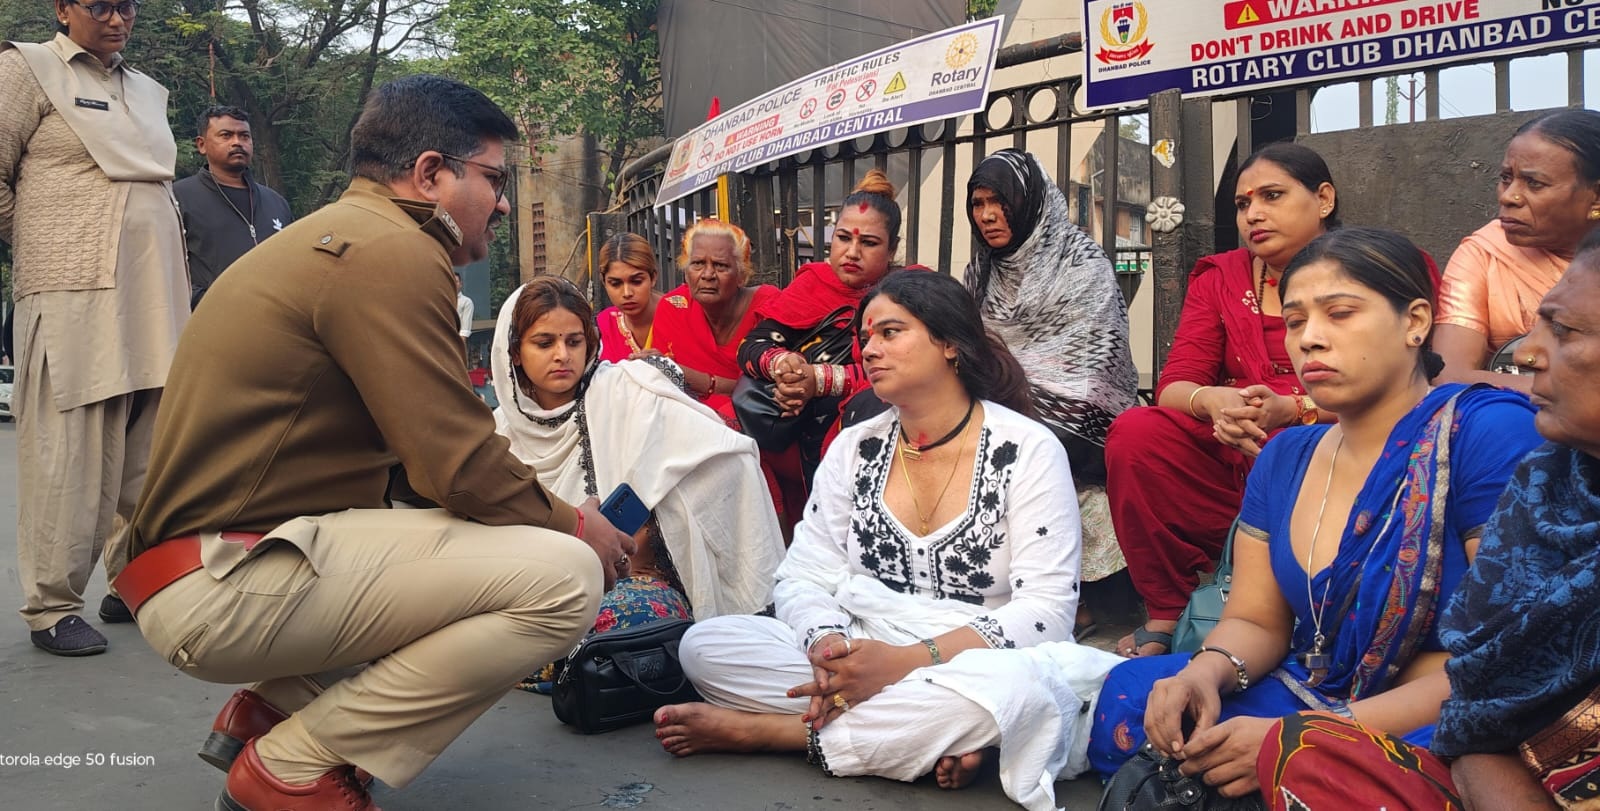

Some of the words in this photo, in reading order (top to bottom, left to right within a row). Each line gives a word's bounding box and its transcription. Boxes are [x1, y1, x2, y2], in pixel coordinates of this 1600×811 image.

[1191, 34, 1253, 62] DON'T
[1260, 22, 1334, 51] DRINK
[1340, 13, 1392, 39] AND
[1401, 0, 1480, 29] DRIVE
[814, 65, 858, 88] TRAFFIC
[861, 52, 901, 72] RULES
[1098, 64, 1127, 73] DHANBAD
[1128, 59, 1152, 68] POLICE
[1192, 54, 1297, 88] ROTARY
[1307, 42, 1382, 72] CLUB
[1392, 16, 1551, 60] DHANBAD
[931, 66, 982, 87] Rotary
[703, 108, 755, 141] DHANBAD
[757, 88, 802, 117] POLICE
[736, 117, 775, 141] WARNING
[694, 158, 734, 187] ROTARY
[735, 147, 764, 168] CLUB
[766, 126, 831, 157] DHANBAD
[834, 107, 904, 136] CENTRAL
[714, 150, 725, 161] DO
[726, 143, 741, 156] NOT
[743, 137, 757, 149] USE
[759, 126, 784, 142] HORN
